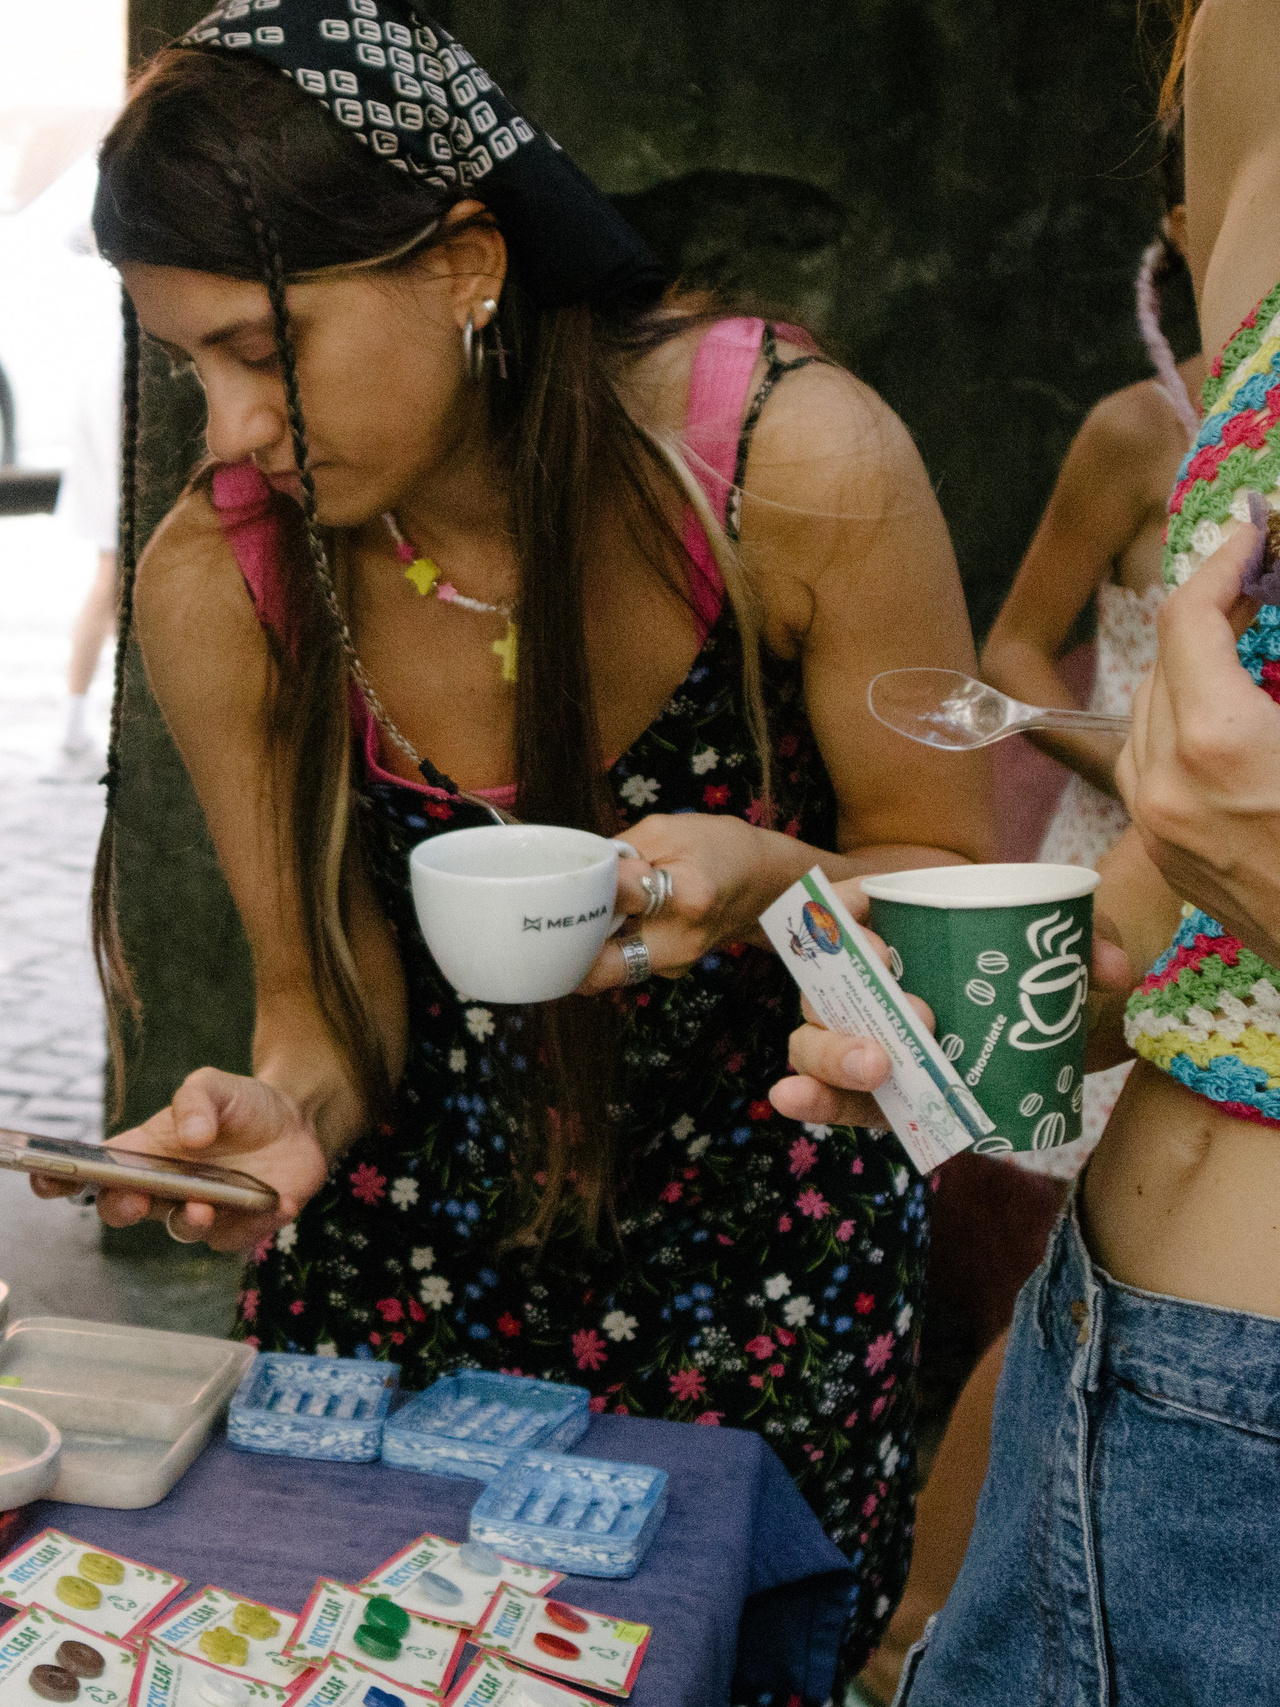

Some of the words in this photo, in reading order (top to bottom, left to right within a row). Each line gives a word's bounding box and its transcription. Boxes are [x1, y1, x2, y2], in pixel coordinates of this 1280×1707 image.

[546, 905, 608, 929] MEAMA
[841, 974, 862, 1005] ANNA
[850, 953, 871, 988] TEA
[870, 985, 888, 1009] AND
[886, 1008, 927, 1069] TRAVEL
[966, 1013, 1008, 1087] Chocolate
[7, 1543, 63, 1584] RECYCLEAF
[382, 1549, 439, 1588] RECYCLEAF
[160, 1604, 219, 1643] RECYCLEAF
[307, 1598, 345, 1650] RECYCLEAF
[493, 1600, 525, 1640] RECYCLEAF
[147, 1659, 173, 1707] CYCLEAF
[304, 1675, 348, 1707] YCLEAF
[463, 1672, 502, 1707] YCLEAF
